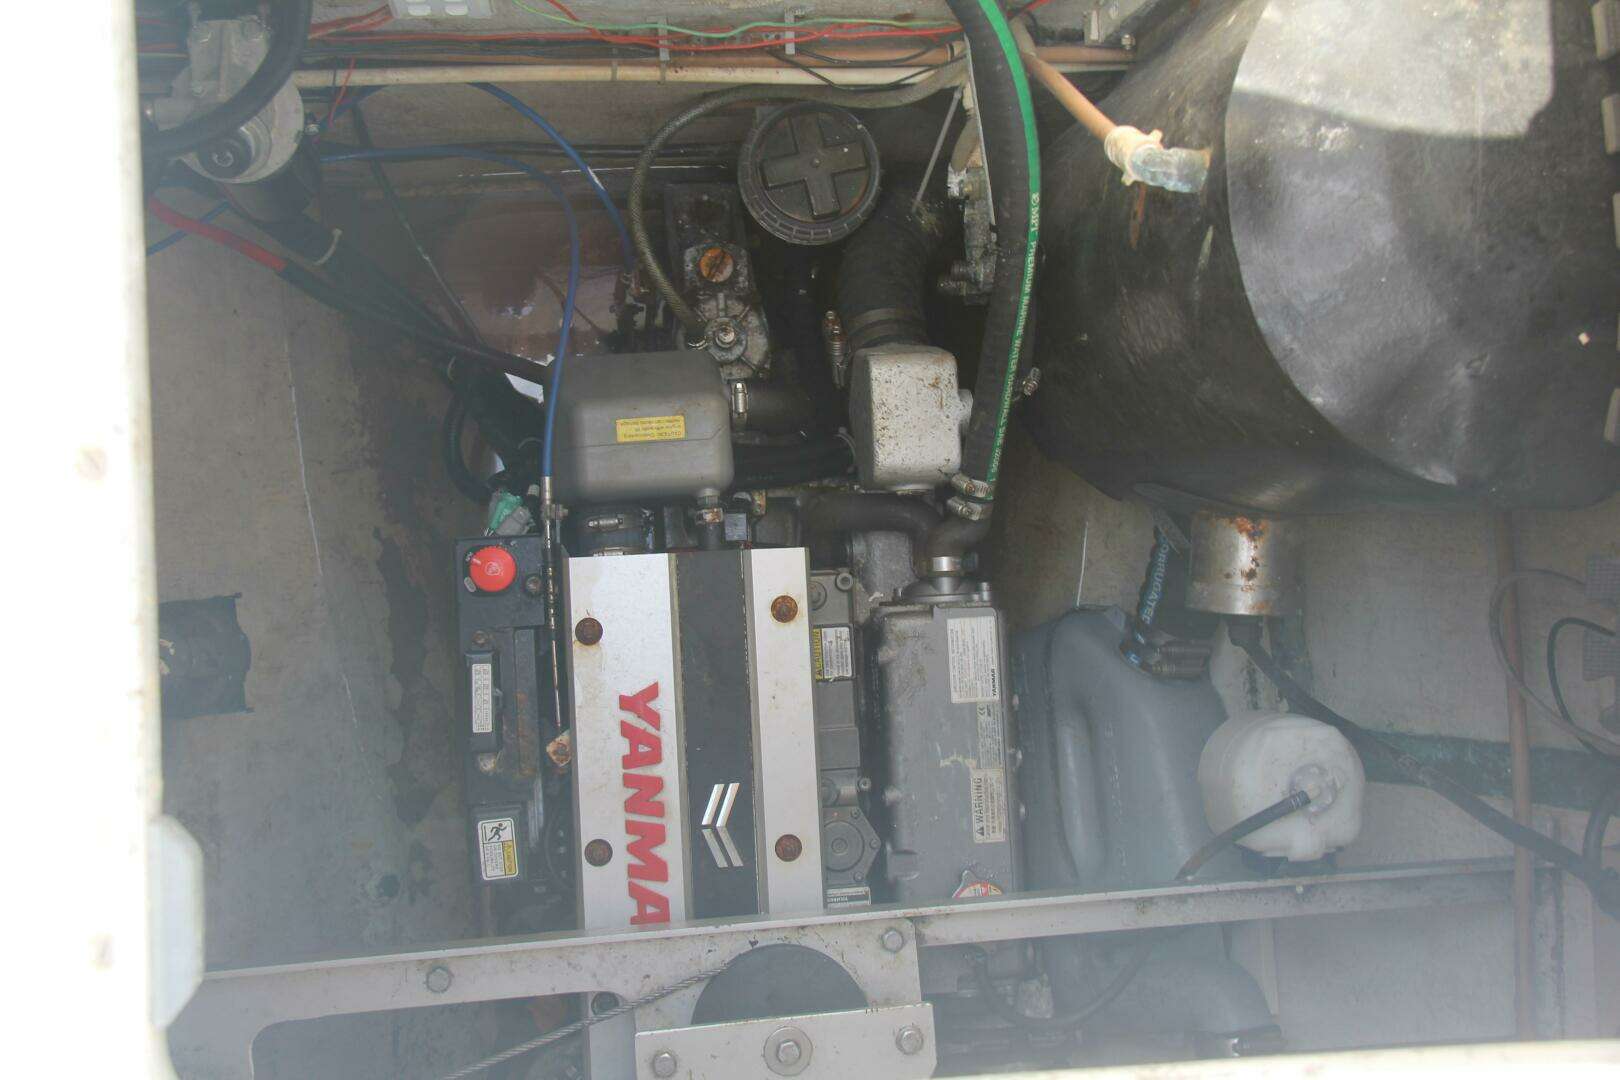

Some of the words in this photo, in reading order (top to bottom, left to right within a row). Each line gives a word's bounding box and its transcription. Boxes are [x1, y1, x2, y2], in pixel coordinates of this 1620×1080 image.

[1025, 241, 1037, 294] PREMIUM
[1008, 338, 1021, 372] WATER
[973, 778, 985, 824] WARNING
